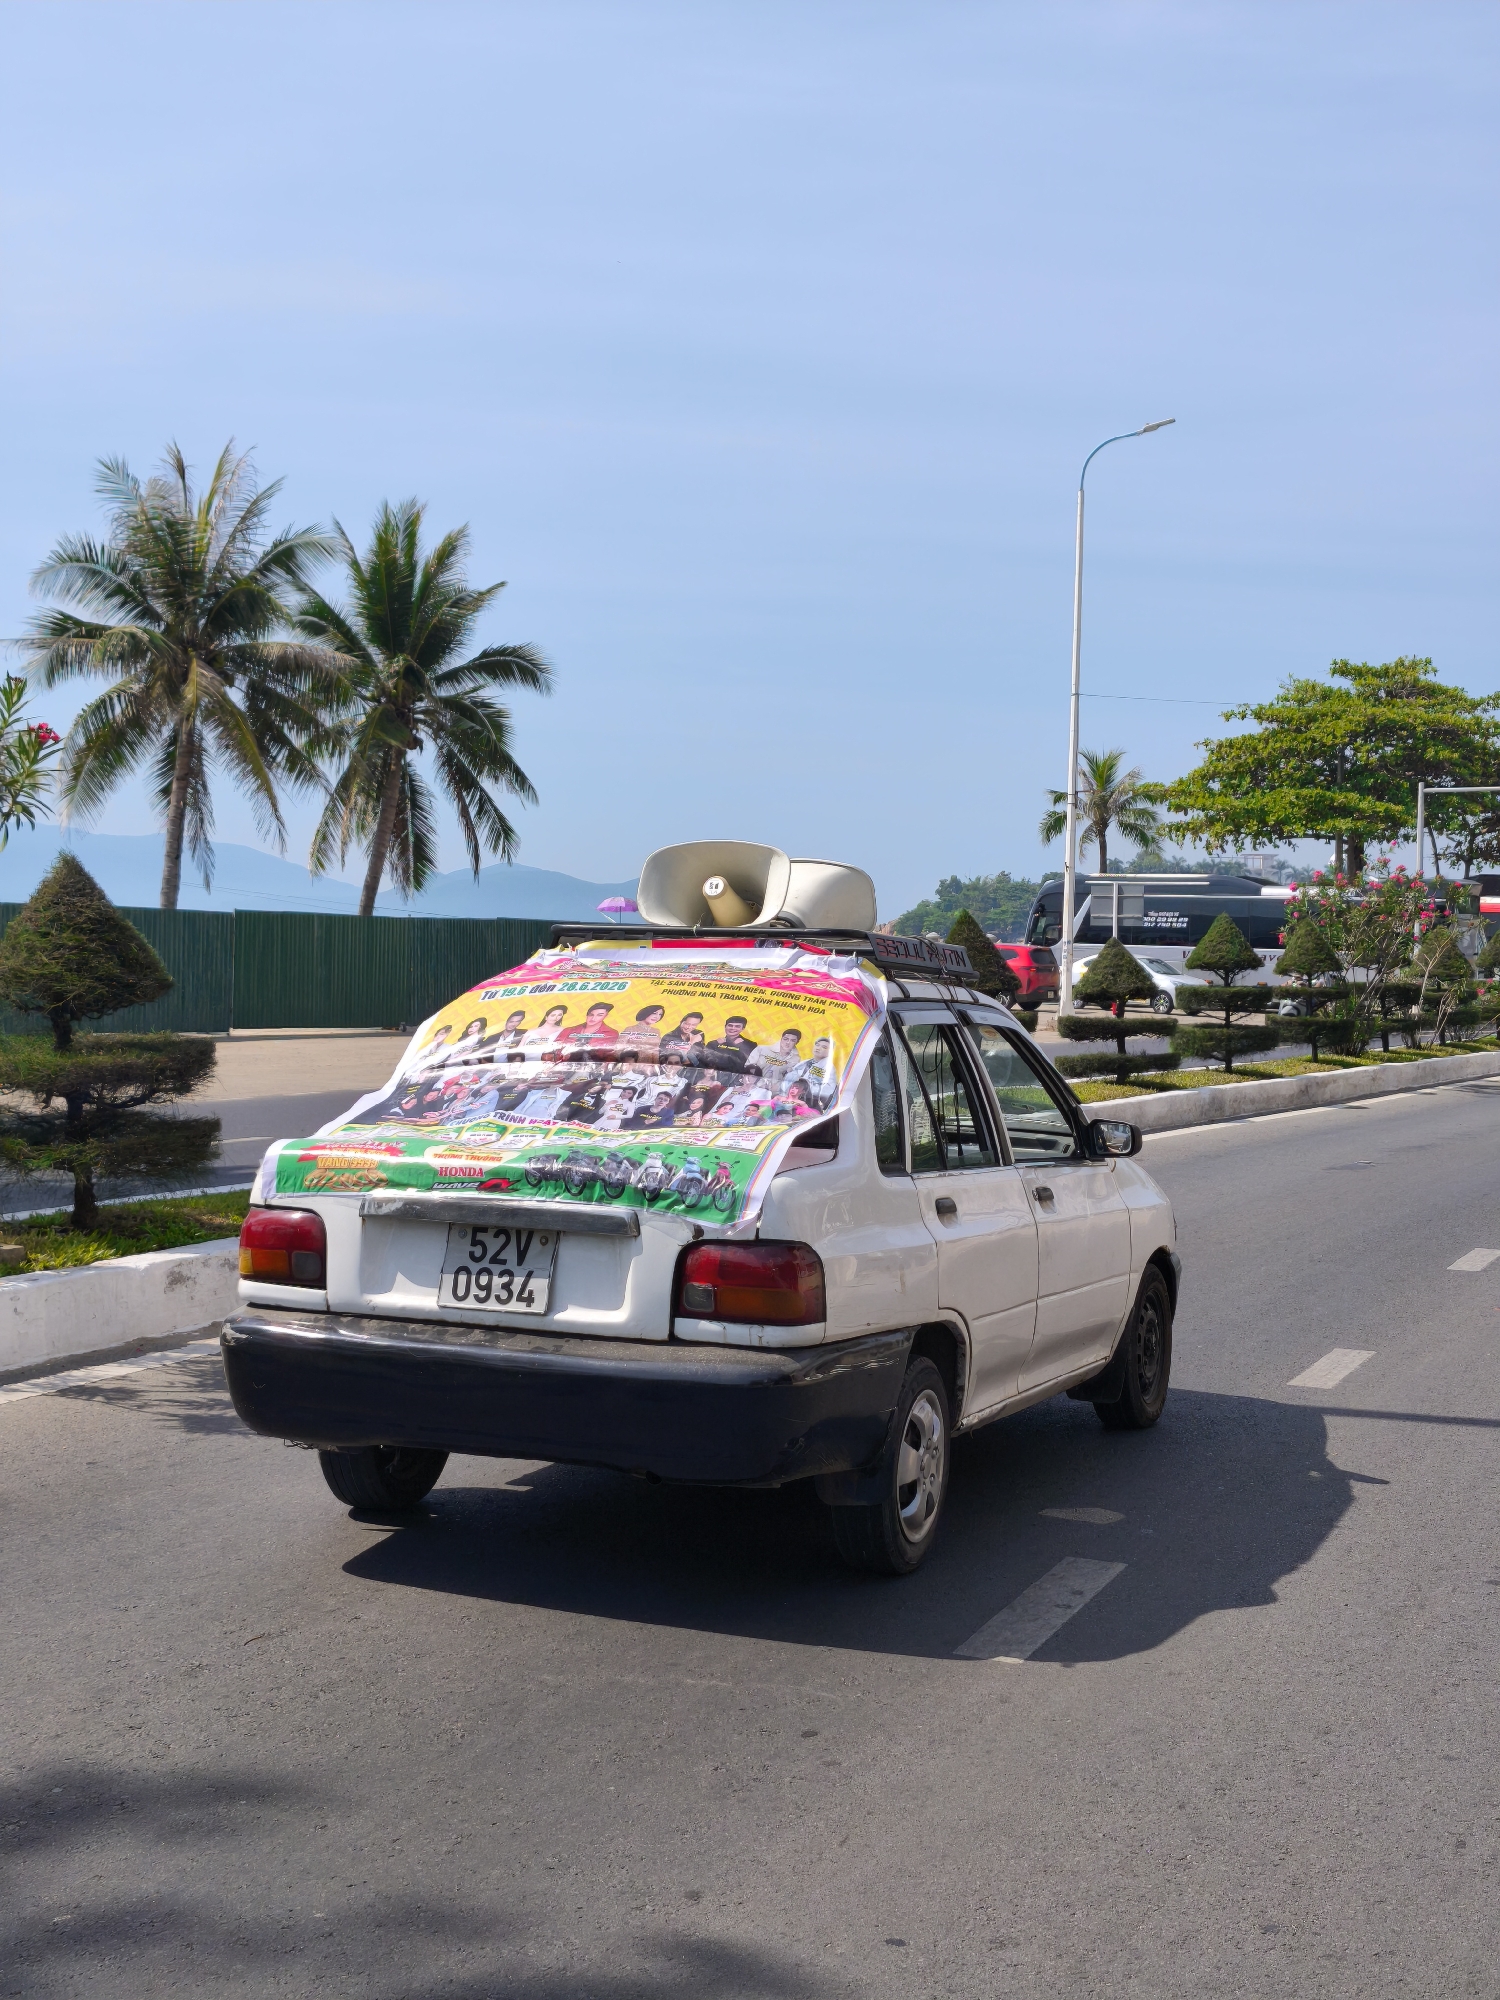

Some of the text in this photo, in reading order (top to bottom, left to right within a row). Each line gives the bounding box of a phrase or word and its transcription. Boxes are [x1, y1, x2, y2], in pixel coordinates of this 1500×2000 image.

[500, 985, 529, 998] 19.6
[557, 980, 629, 992] 28.6.2026
[698, 990, 717, 999] NHA
[438, 1166, 485, 1178] HONDA
[468, 1226, 535, 1267] 52V
[451, 1265, 536, 1308] 0934
